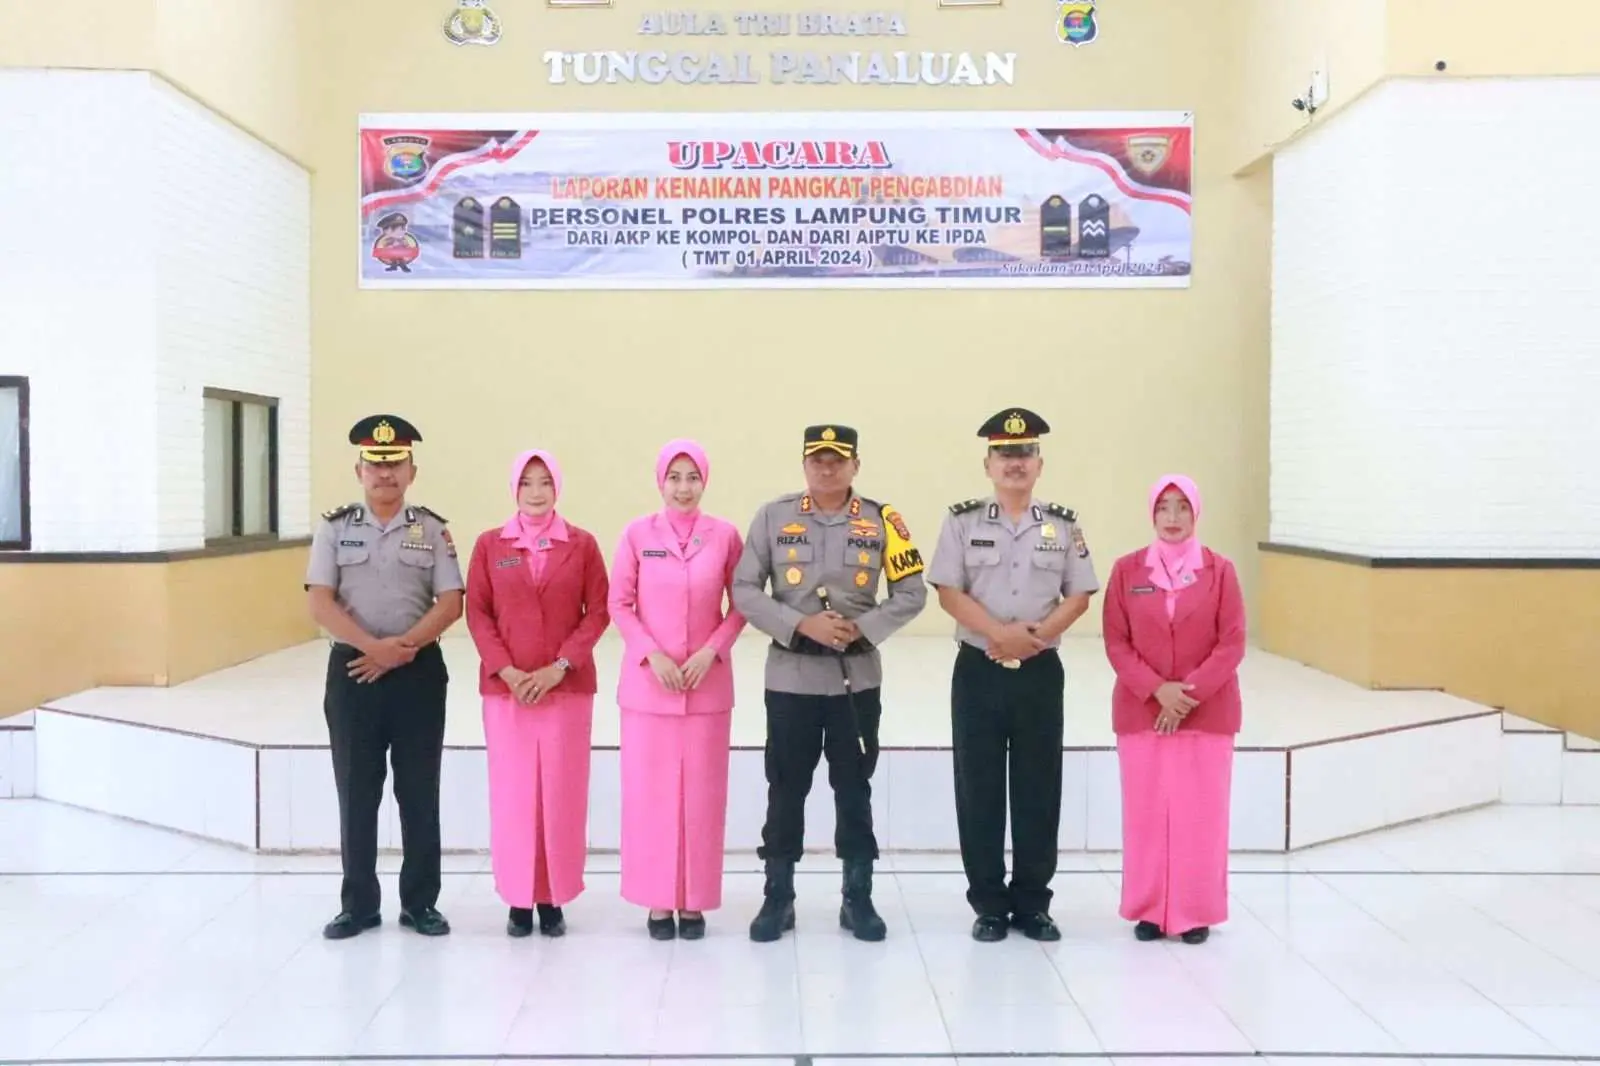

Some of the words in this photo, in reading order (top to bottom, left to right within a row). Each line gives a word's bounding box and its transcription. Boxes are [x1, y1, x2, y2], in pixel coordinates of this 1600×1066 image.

[637, 12, 728, 36] AULA
[734, 12, 791, 36] TRI
[797, 12, 908, 36] BRATA
[542, 50, 760, 84] TUNGGAL
[770, 51, 1018, 85] PANALUAN
[666, 140, 893, 170] UPACARA
[552, 176, 649, 199] LAPORAN
[655, 176, 762, 199] KENAIKAN
[768, 175, 864, 199] PANGKAT
[870, 175, 1004, 198] PENGABDIAN
[532, 207, 673, 225] PERSONEL
[682, 207, 786, 225] POLRES
[795, 207, 927, 224] LAMPUNG
[935, 206, 1022, 224] TIMUR
[567, 230, 608, 245] DARI
[614, 230, 650, 245] AKP
[656, 230, 681, 245] KE
[686, 230, 761, 245] KOMPOL
[767, 229, 803, 244] DAN
[809, 229, 851, 244] DARI
[856, 229, 910, 244] AIPTU
[916, 229, 940, 244] KE
[946, 229, 986, 244] IPDA
[736, 250, 756, 265] 01
[762, 250, 815, 265] APRIL
[776, 535, 811, 546] RIZAL
[847, 538, 881, 552] POLRI
